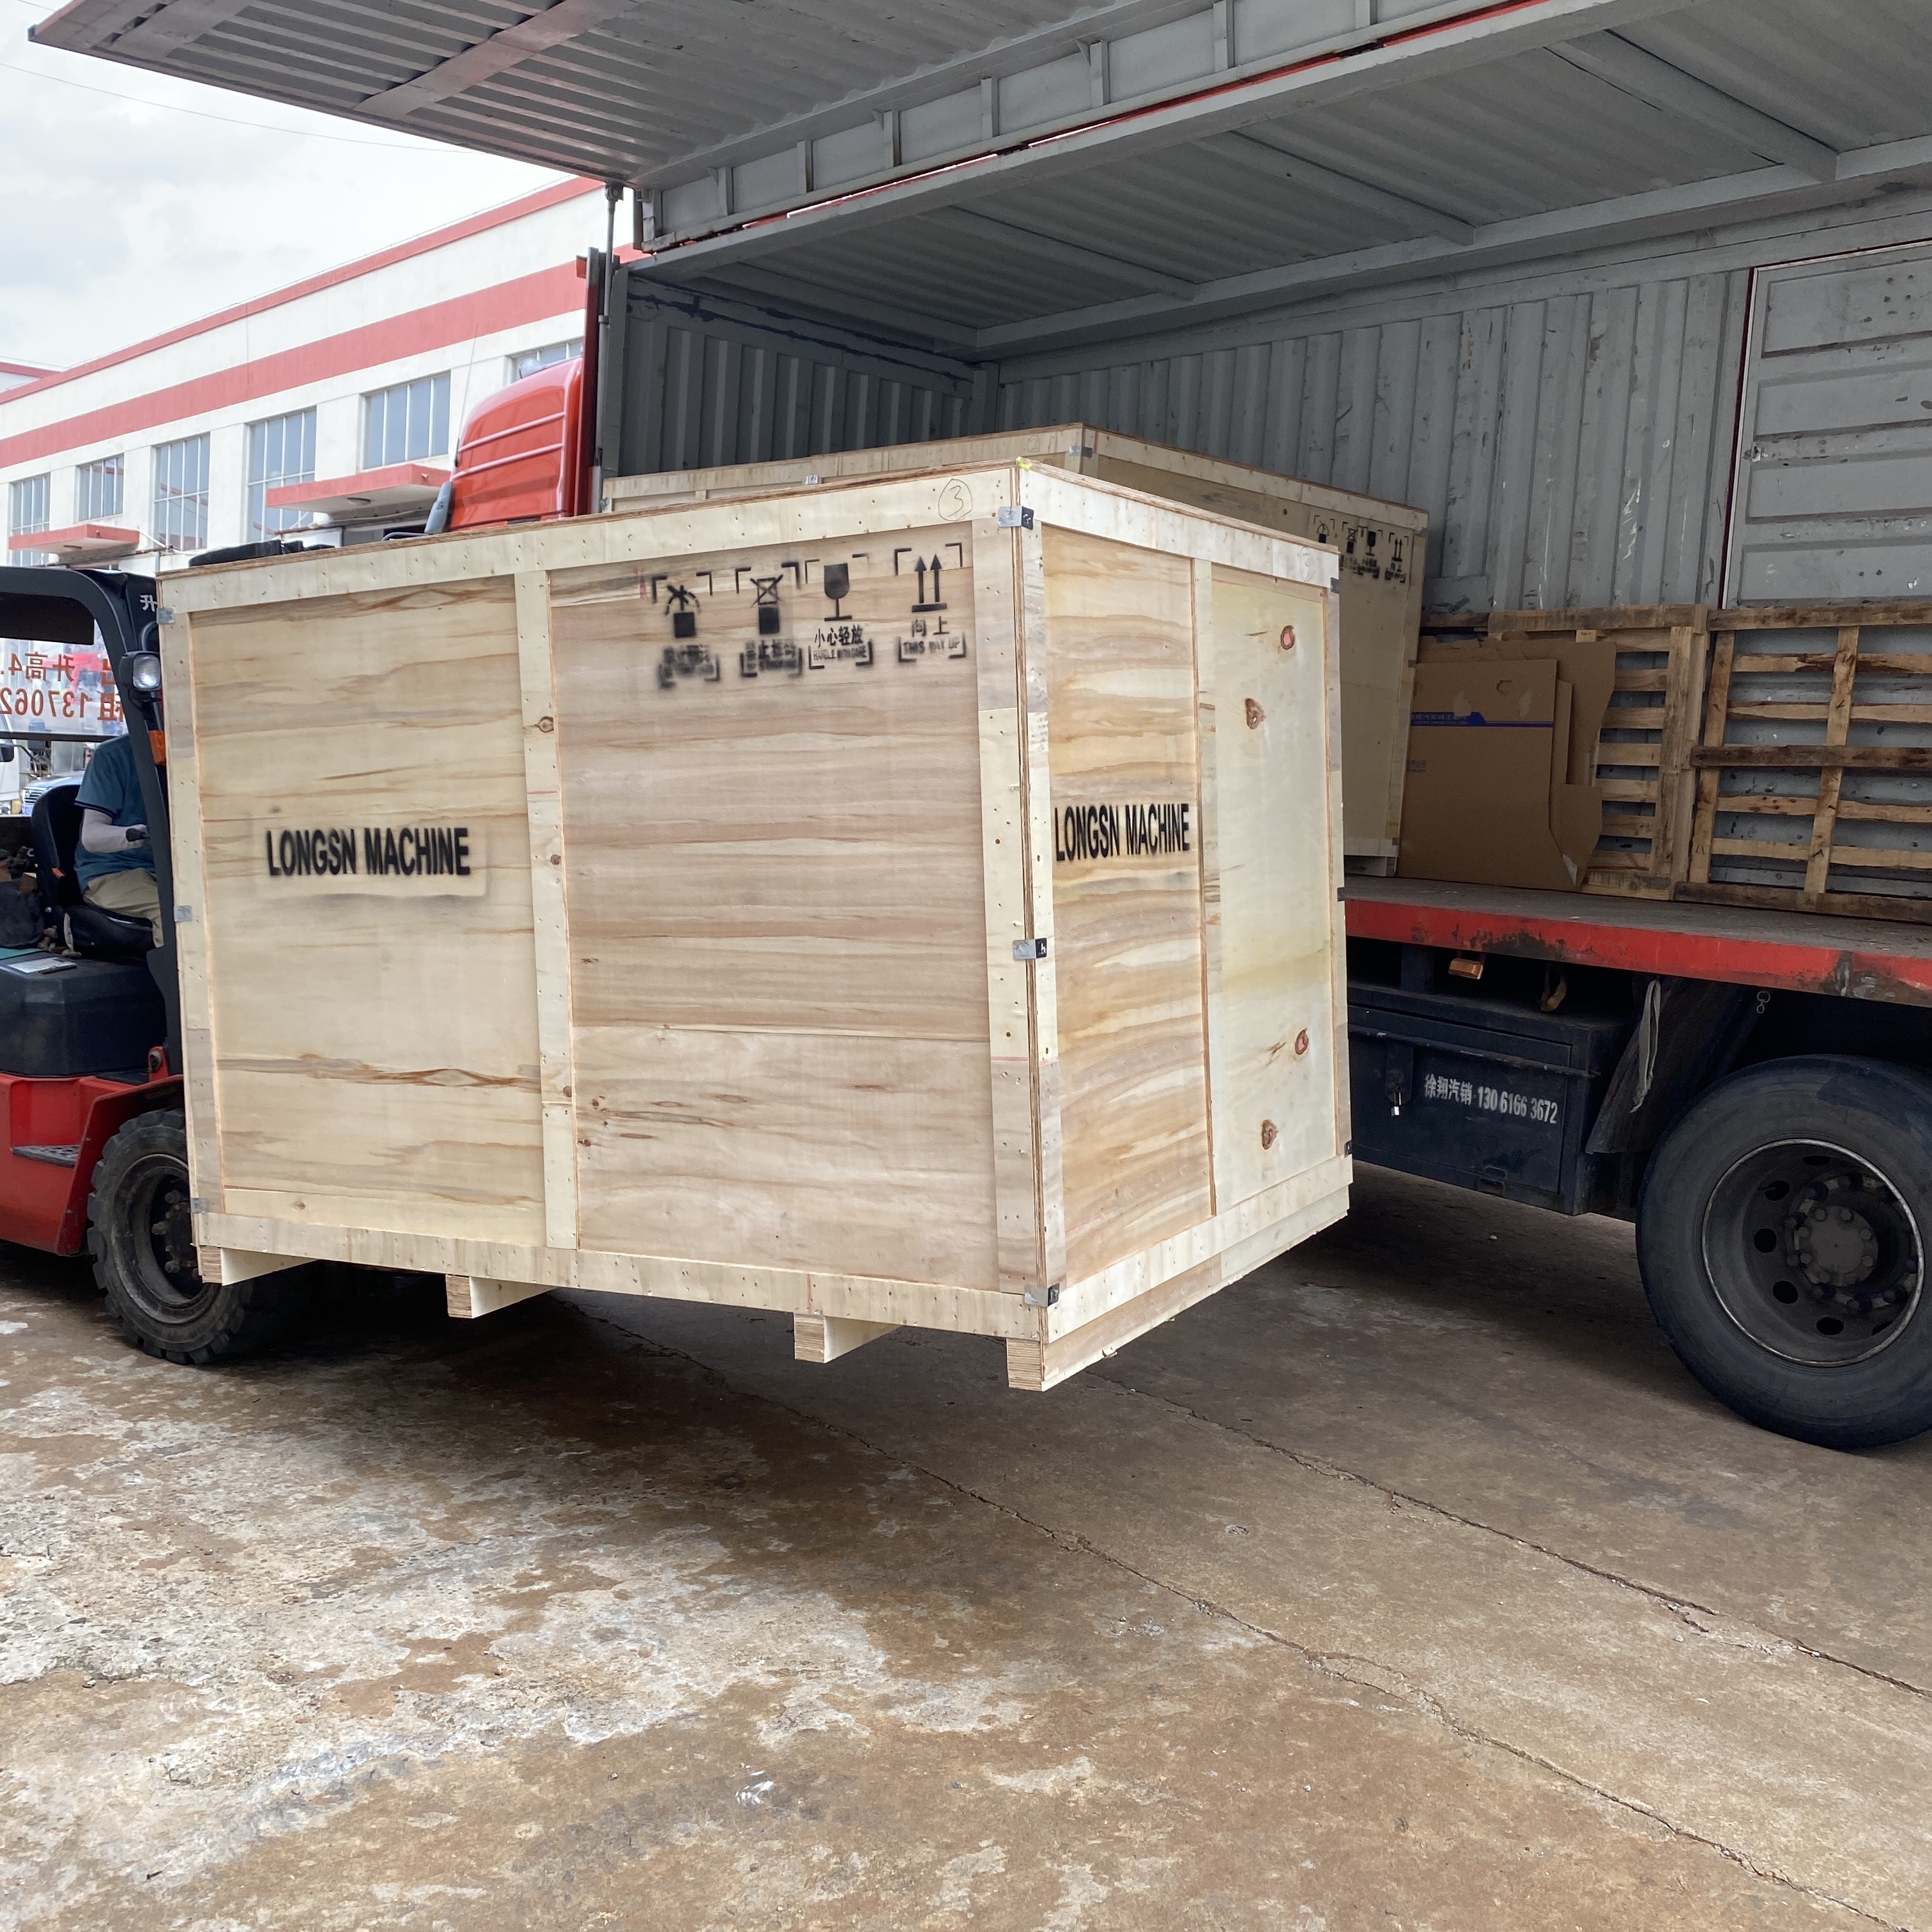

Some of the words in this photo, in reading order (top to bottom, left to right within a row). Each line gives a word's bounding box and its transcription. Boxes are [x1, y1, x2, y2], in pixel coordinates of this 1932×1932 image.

[815, 624, 862, 647] 小心轻放
[912, 616, 949, 638] 向上
[1054, 804, 1121, 861] LONGSN
[1125, 803, 1190, 855] MACHINE
[266, 829, 357, 876] LONGSN
[364, 827, 471, 876] MACHINE
[1477, 1086, 1498, 1111] 130
[1500, 1091, 1528, 1117] 6166
[1530, 1097, 1558, 1124] 3672
